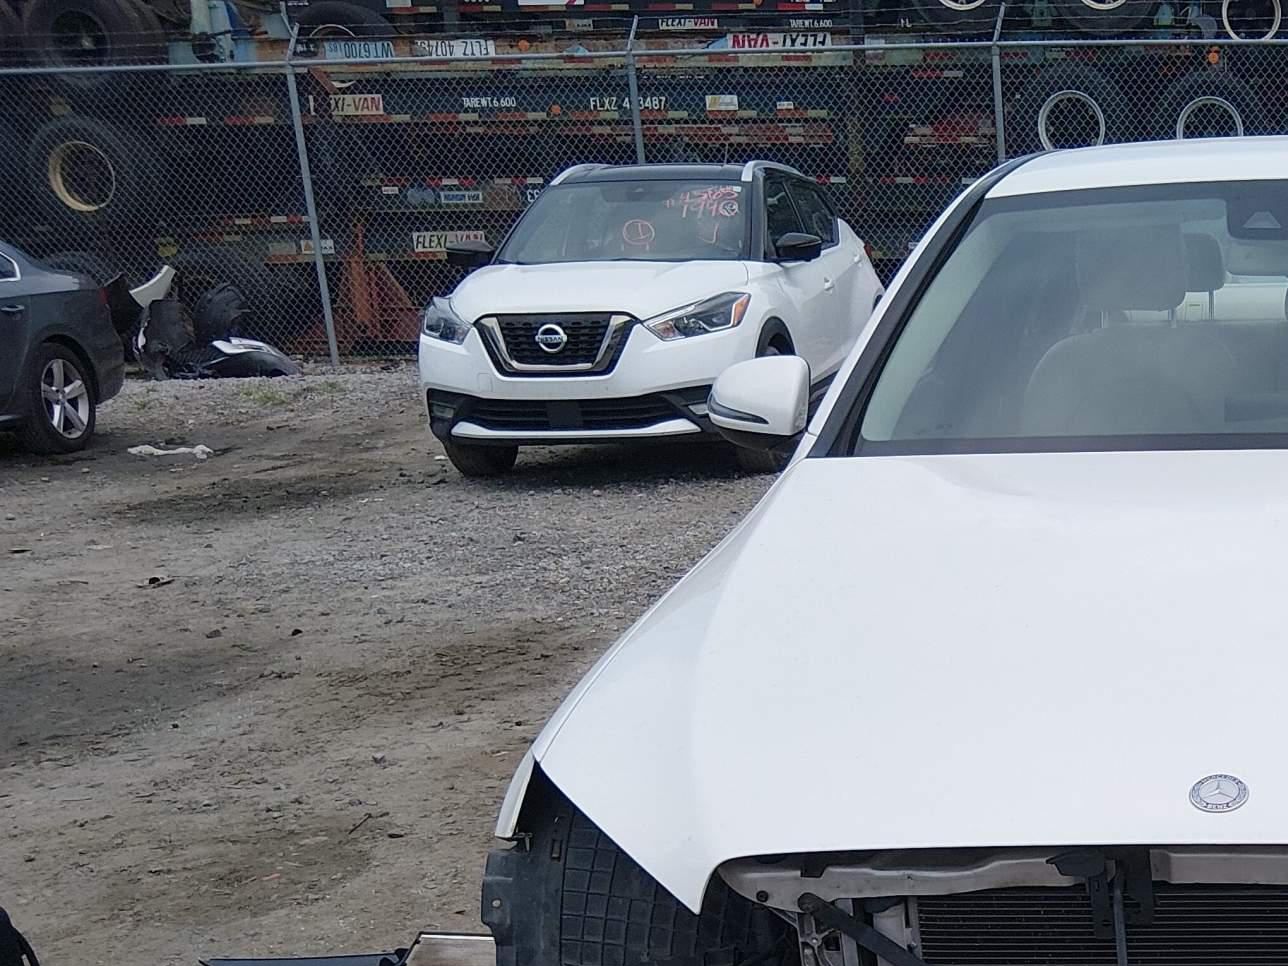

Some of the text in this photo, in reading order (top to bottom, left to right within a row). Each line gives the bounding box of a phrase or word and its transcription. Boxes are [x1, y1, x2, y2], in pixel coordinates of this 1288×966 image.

[731, 33, 827, 47] FLEXI-VAN
[462, 41, 489, 58] FLTZ
[590, 97, 666, 110] FLXZ 43487
[537, 335, 564, 343] NISSAN
